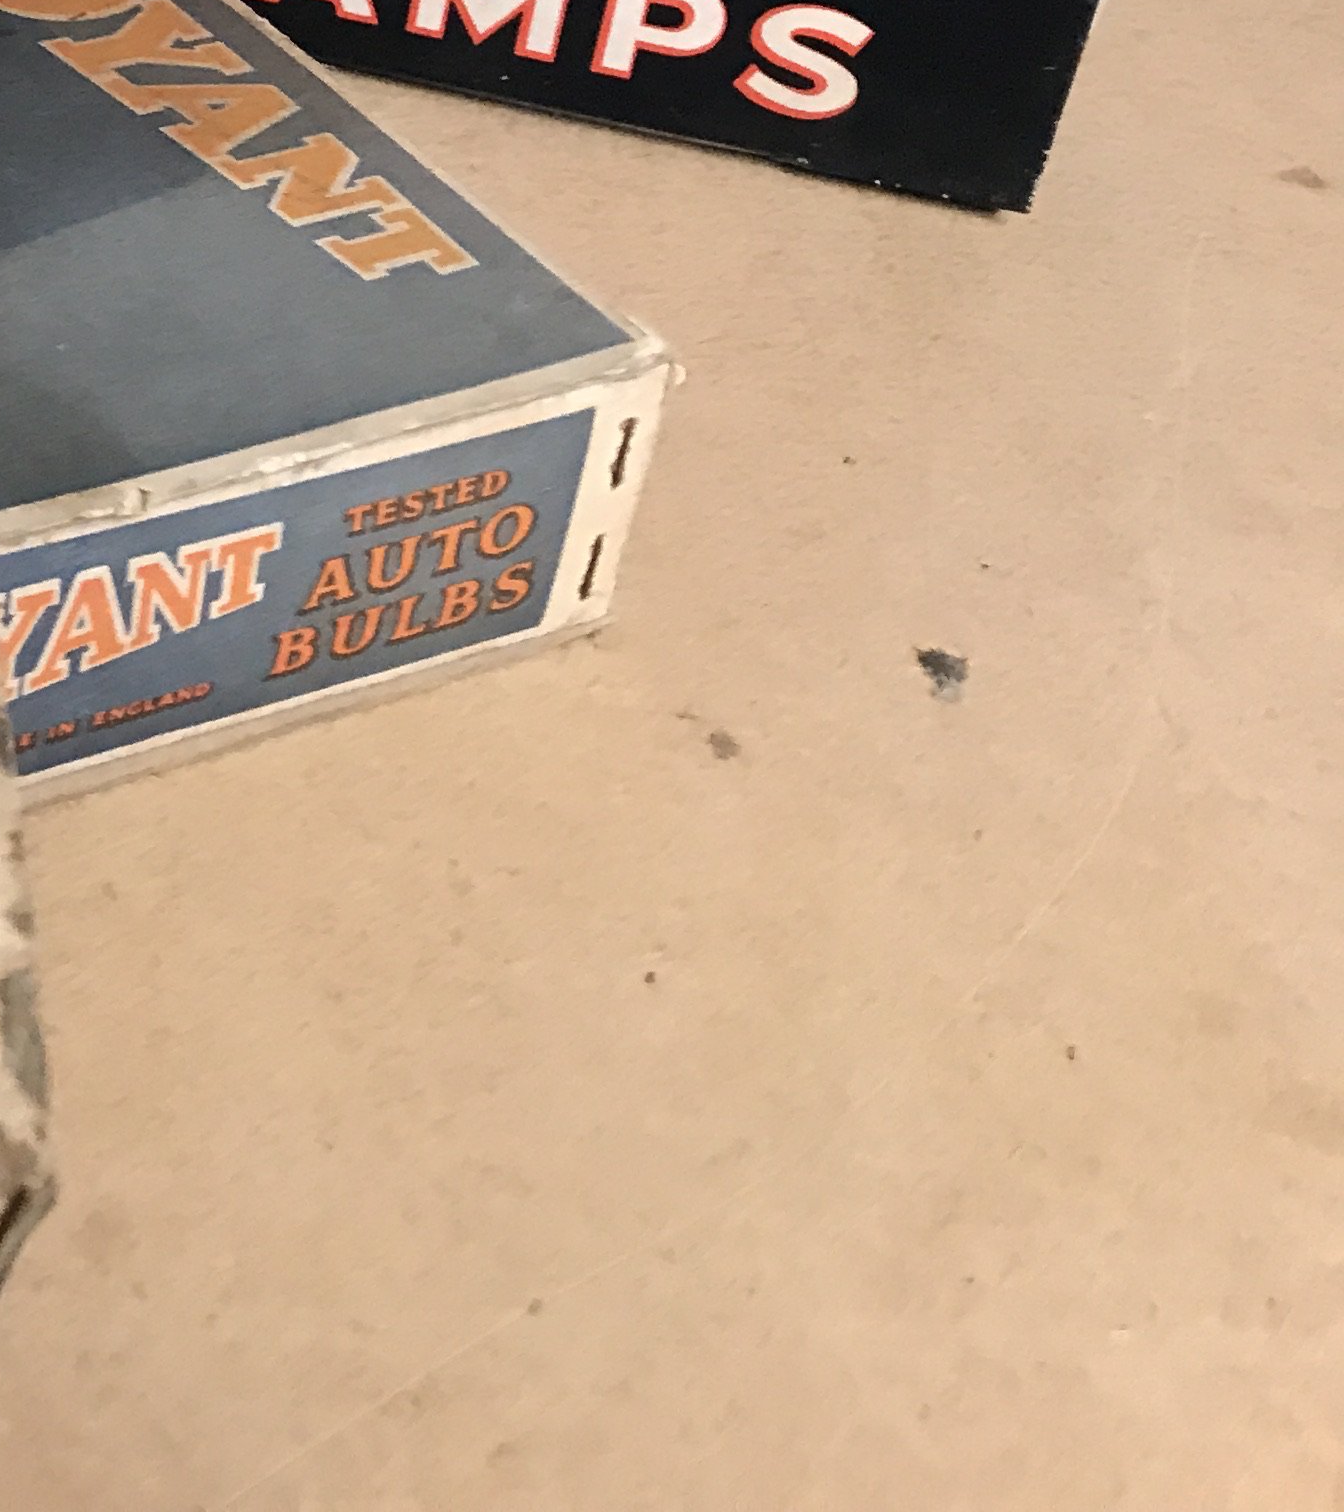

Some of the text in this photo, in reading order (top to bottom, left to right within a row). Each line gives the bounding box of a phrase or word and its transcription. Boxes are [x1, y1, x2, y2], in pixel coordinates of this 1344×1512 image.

[345, 469, 512, 536] TESTED
[297, 503, 537, 615] AUTO
[265, 561, 536, 681] BULBS
[91, 682, 212, 728] ENGLAND
